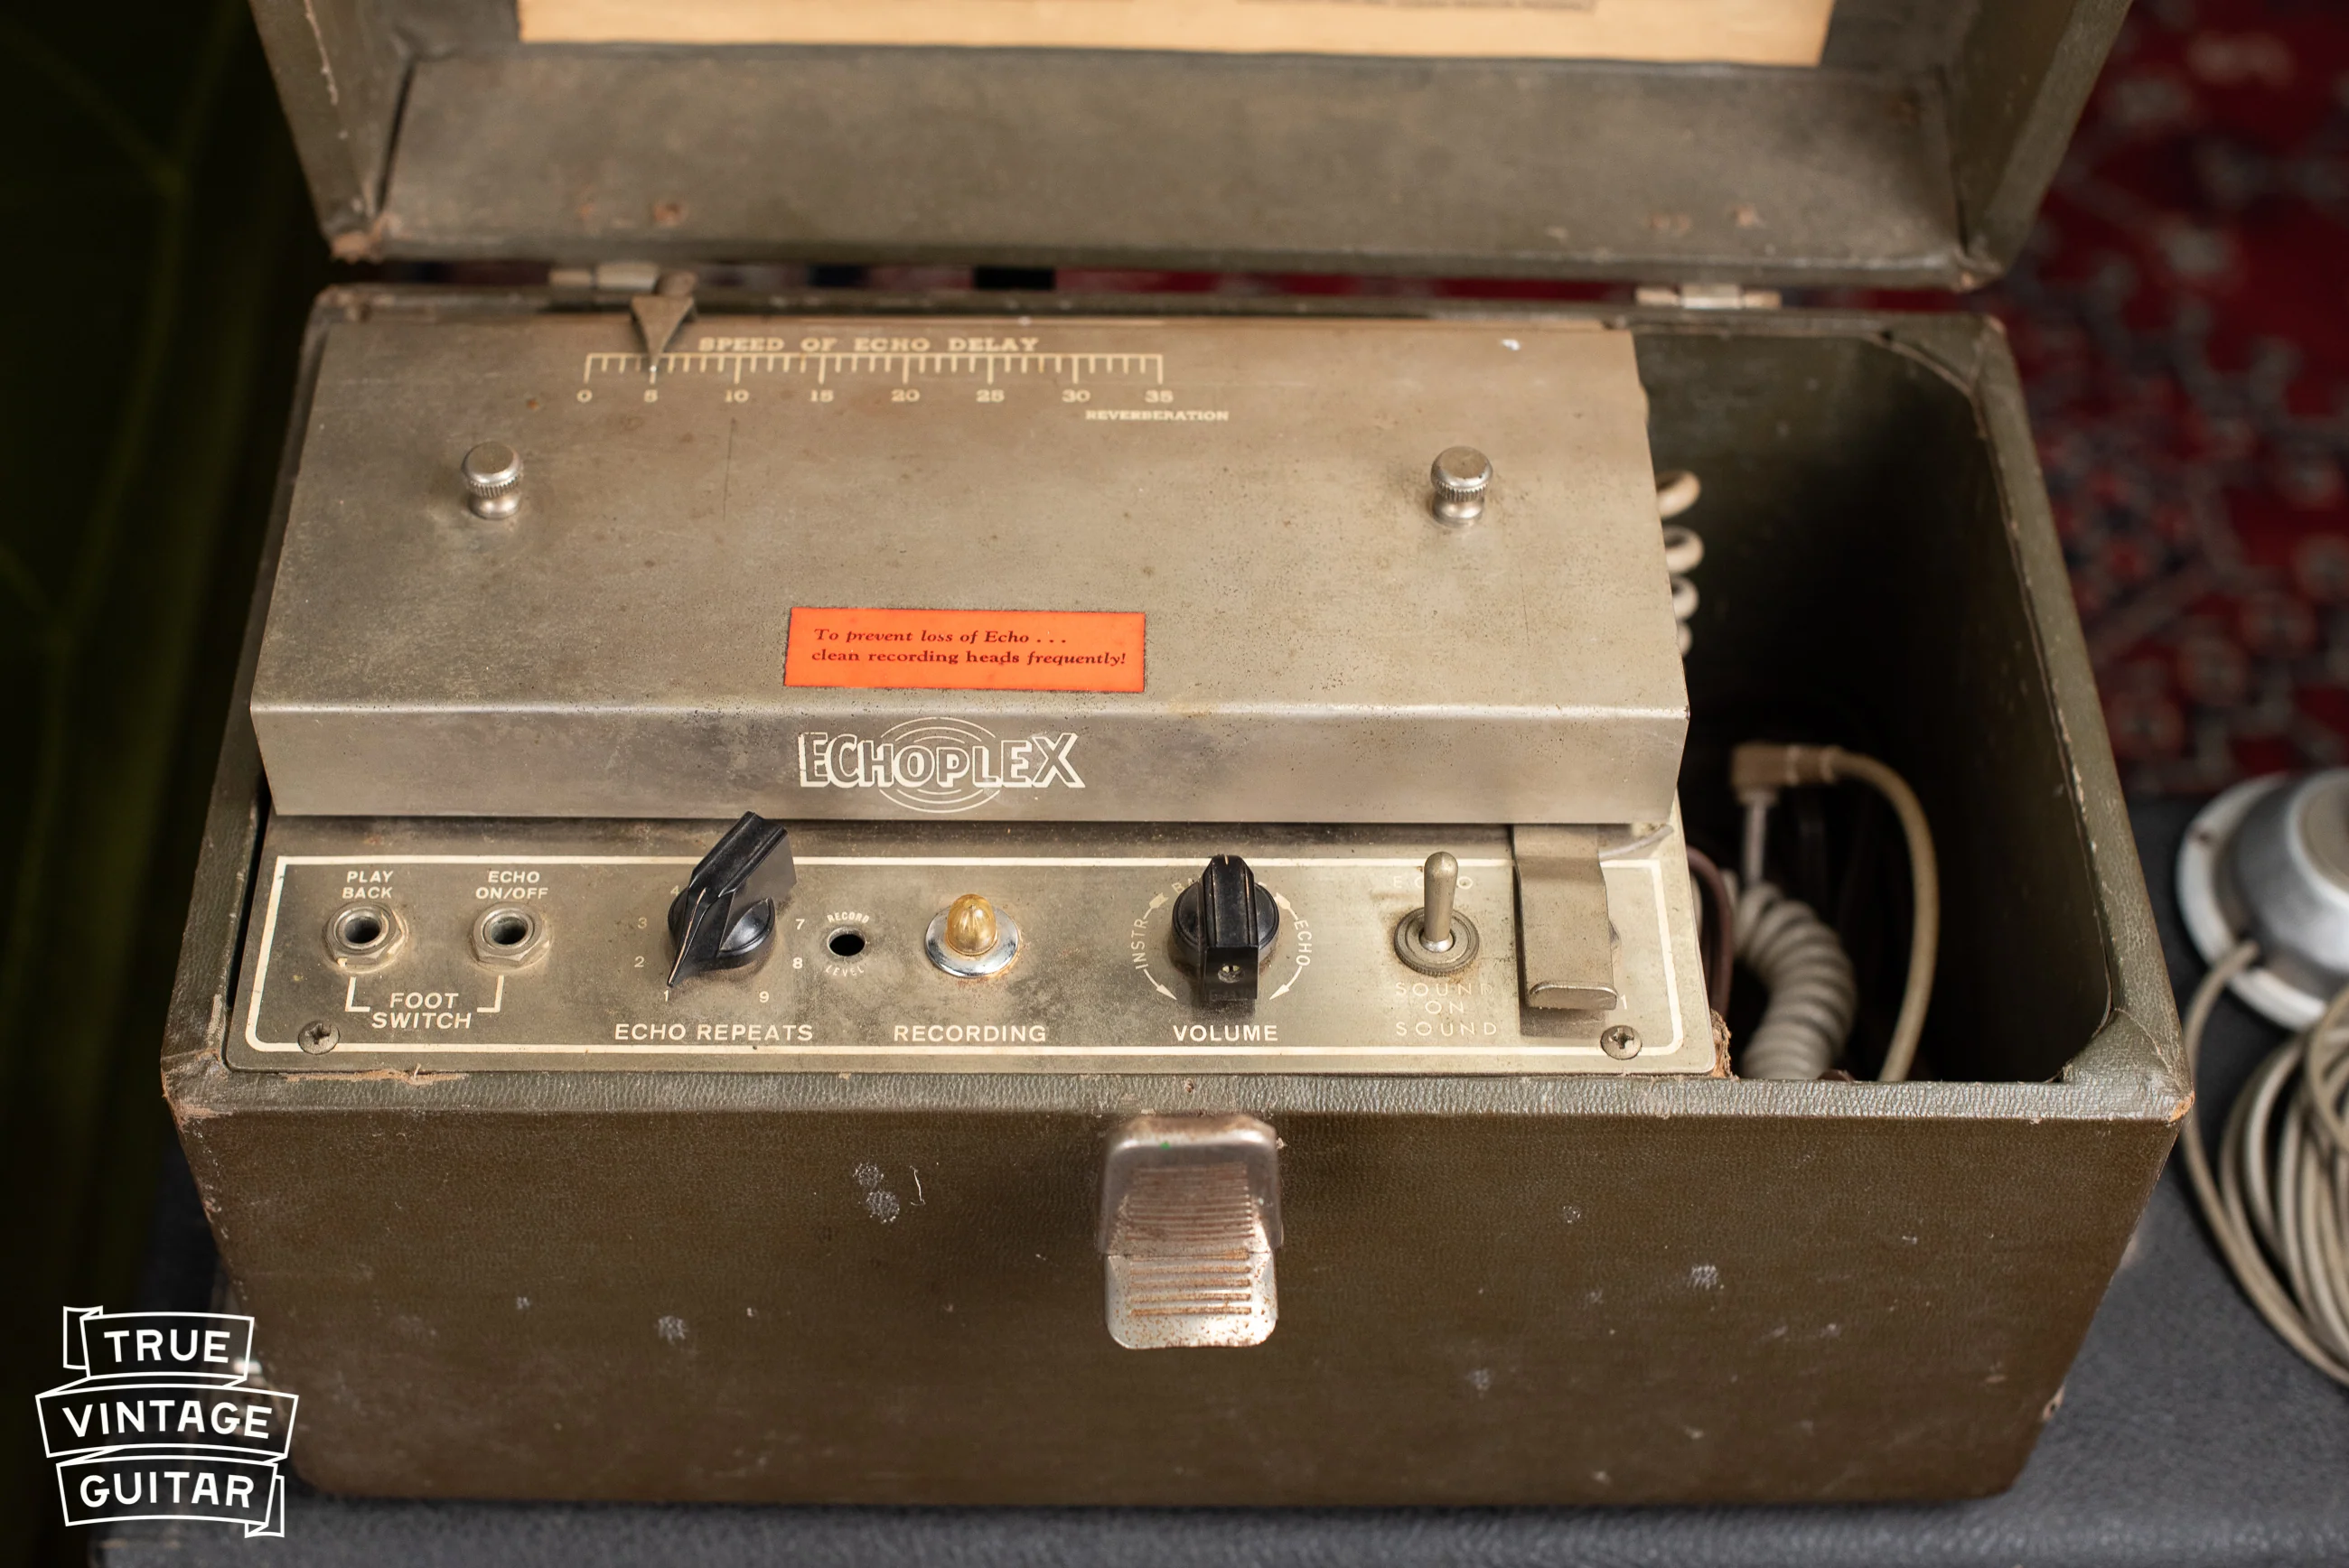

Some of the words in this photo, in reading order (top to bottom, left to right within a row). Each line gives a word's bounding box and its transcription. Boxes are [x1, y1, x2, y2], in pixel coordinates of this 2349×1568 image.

[698, 337, 784, 352] SPEED
[800, 337, 838, 352] OF
[854, 337, 931, 352] ECHO
[948, 337, 1038, 352] DELAY
[576, 389, 593, 403] 0
[643, 389, 658, 403] 5
[725, 389, 750, 403] 10
[810, 389, 834, 403] 15
[891, 389, 921, 403] 20
[976, 389, 1005, 403] 25
[1062, 389, 1090, 403] 30
[1145, 389, 1174, 404] 35
[1085, 410, 1230, 422] REVERBERATION
[814, 629, 839, 641] To
[846, 630, 912, 643] prevent
[921, 630, 953, 643] loss
[959, 630, 978, 644] of
[984, 630, 1030, 643] Echo
[811, 649, 860, 661] clean
[868, 650, 959, 665] recording
[966, 650, 1020, 665] heads
[1027, 651, 1126, 667] frequently!
[798, 732, 1086, 789] ECHOPLEX
[346, 871, 394, 883] PLAY
[488, 871, 540, 883] ECHO
[1393, 876, 1474, 890] ECO
[342, 887, 393, 900] BACK
[475, 887, 548, 900] ON/OFF
[637, 917, 647, 929] 3
[827, 911, 870, 923] RECORD
[795, 919, 805, 930] 7
[1130, 918, 1149, 970] INSTR
[1293, 919, 1313, 966] ECHO
[634, 956, 645, 967] 2
[792, 957, 803, 969] 8
[825, 964, 865, 976] LEVEL
[1395, 982, 1493, 995] SOUND
[389, 993, 459, 1009] FOOT
[663, 990, 669, 1002] 1
[759, 991, 770, 1003] 9
[1425, 1001, 1464, 1014] ON
[371, 1013, 472, 1029] SWITCH
[614, 1023, 687, 1041] ECHO
[697, 1024, 813, 1041] REPEATS
[894, 1024, 1046, 1041] RECORDING
[1173, 1024, 1278, 1041] VOLUME
[1395, 1022, 1497, 1036] SOUND
